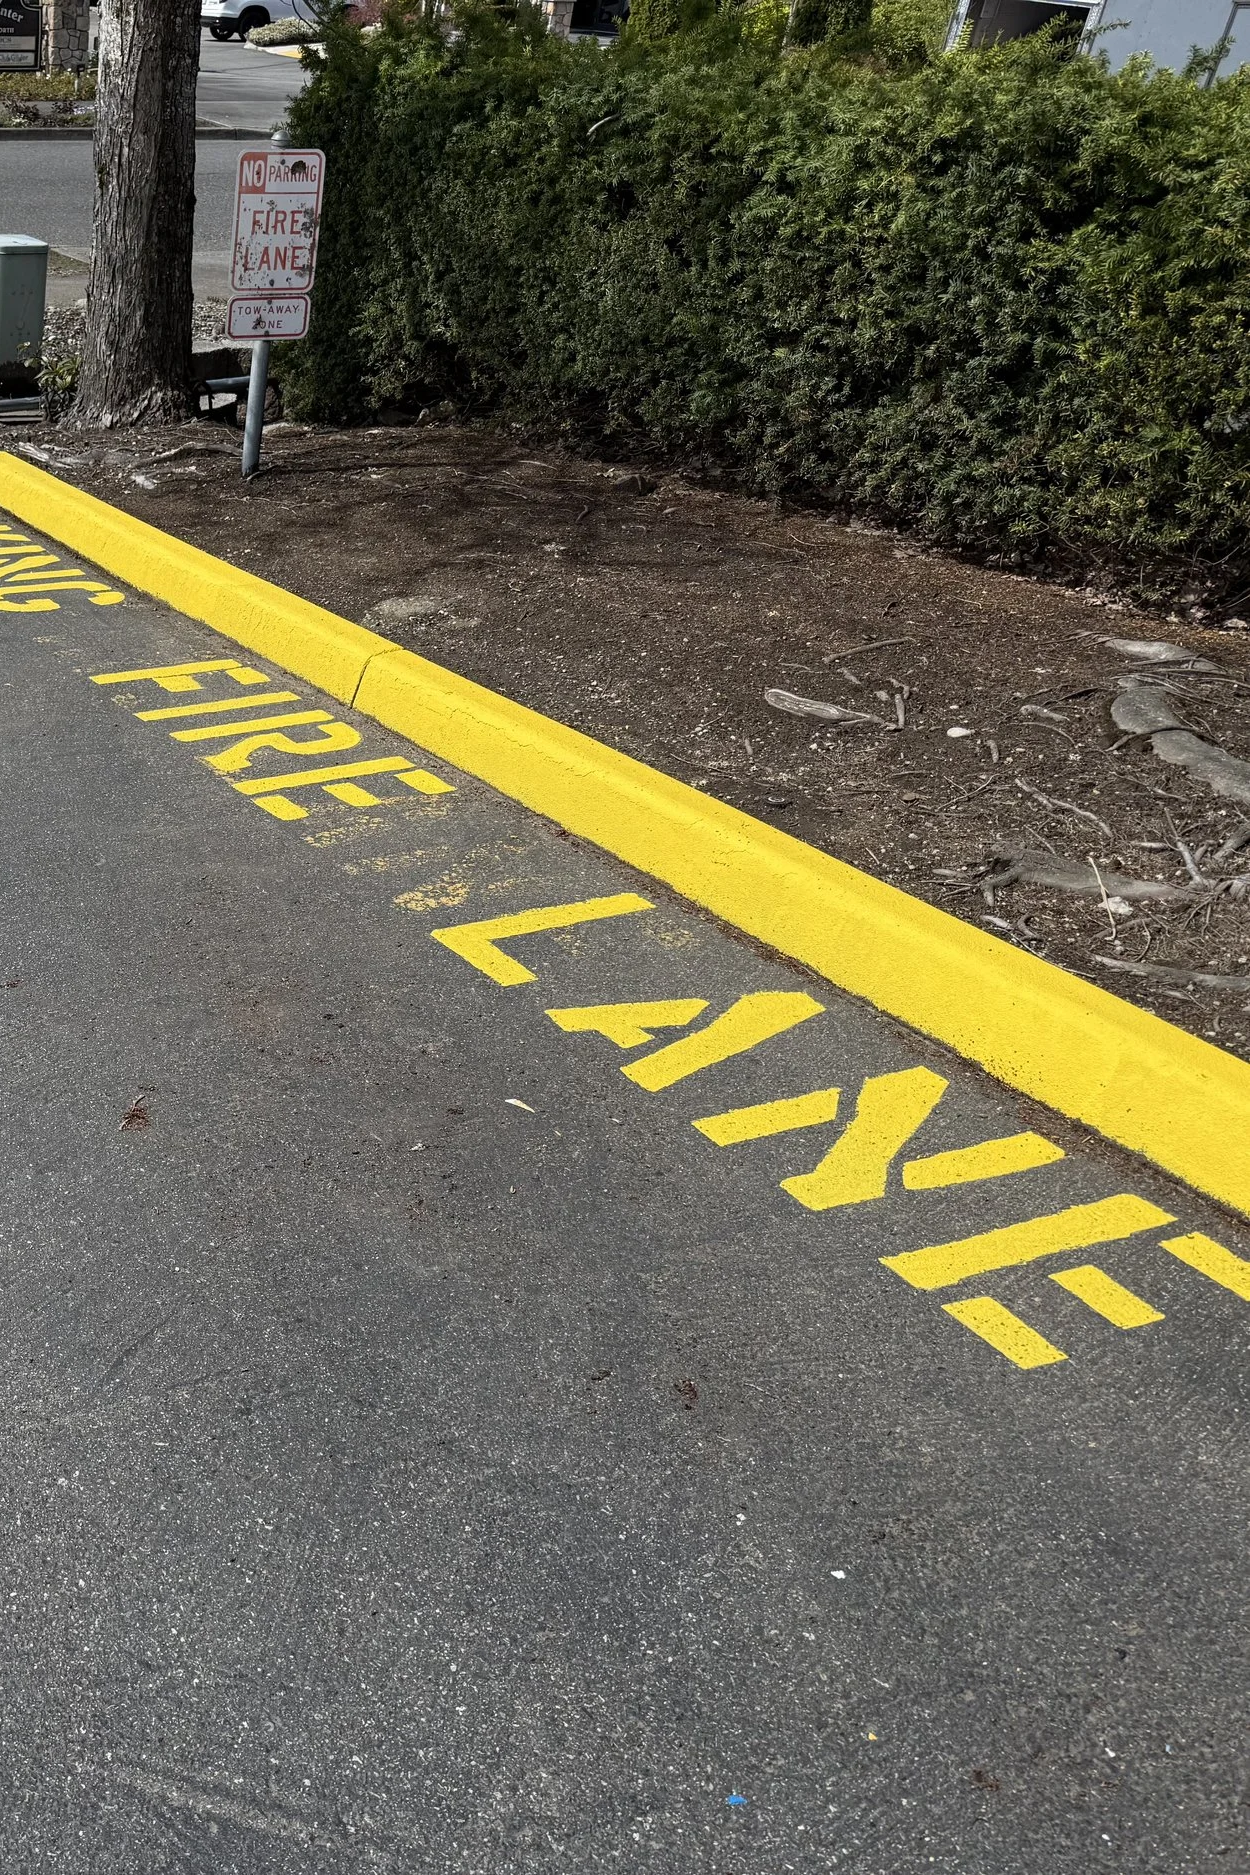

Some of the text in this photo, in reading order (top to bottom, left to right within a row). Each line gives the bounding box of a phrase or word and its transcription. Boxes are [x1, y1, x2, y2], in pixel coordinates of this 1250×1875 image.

[241, 160, 266, 188] NO
[251, 210, 304, 236] FIRE
[243, 246, 306, 273] LANE
[237, 305, 300, 316] TOW-AWAY
[89, 659, 457, 821] FIRE
[431, 892, 1250, 1369] LANE
